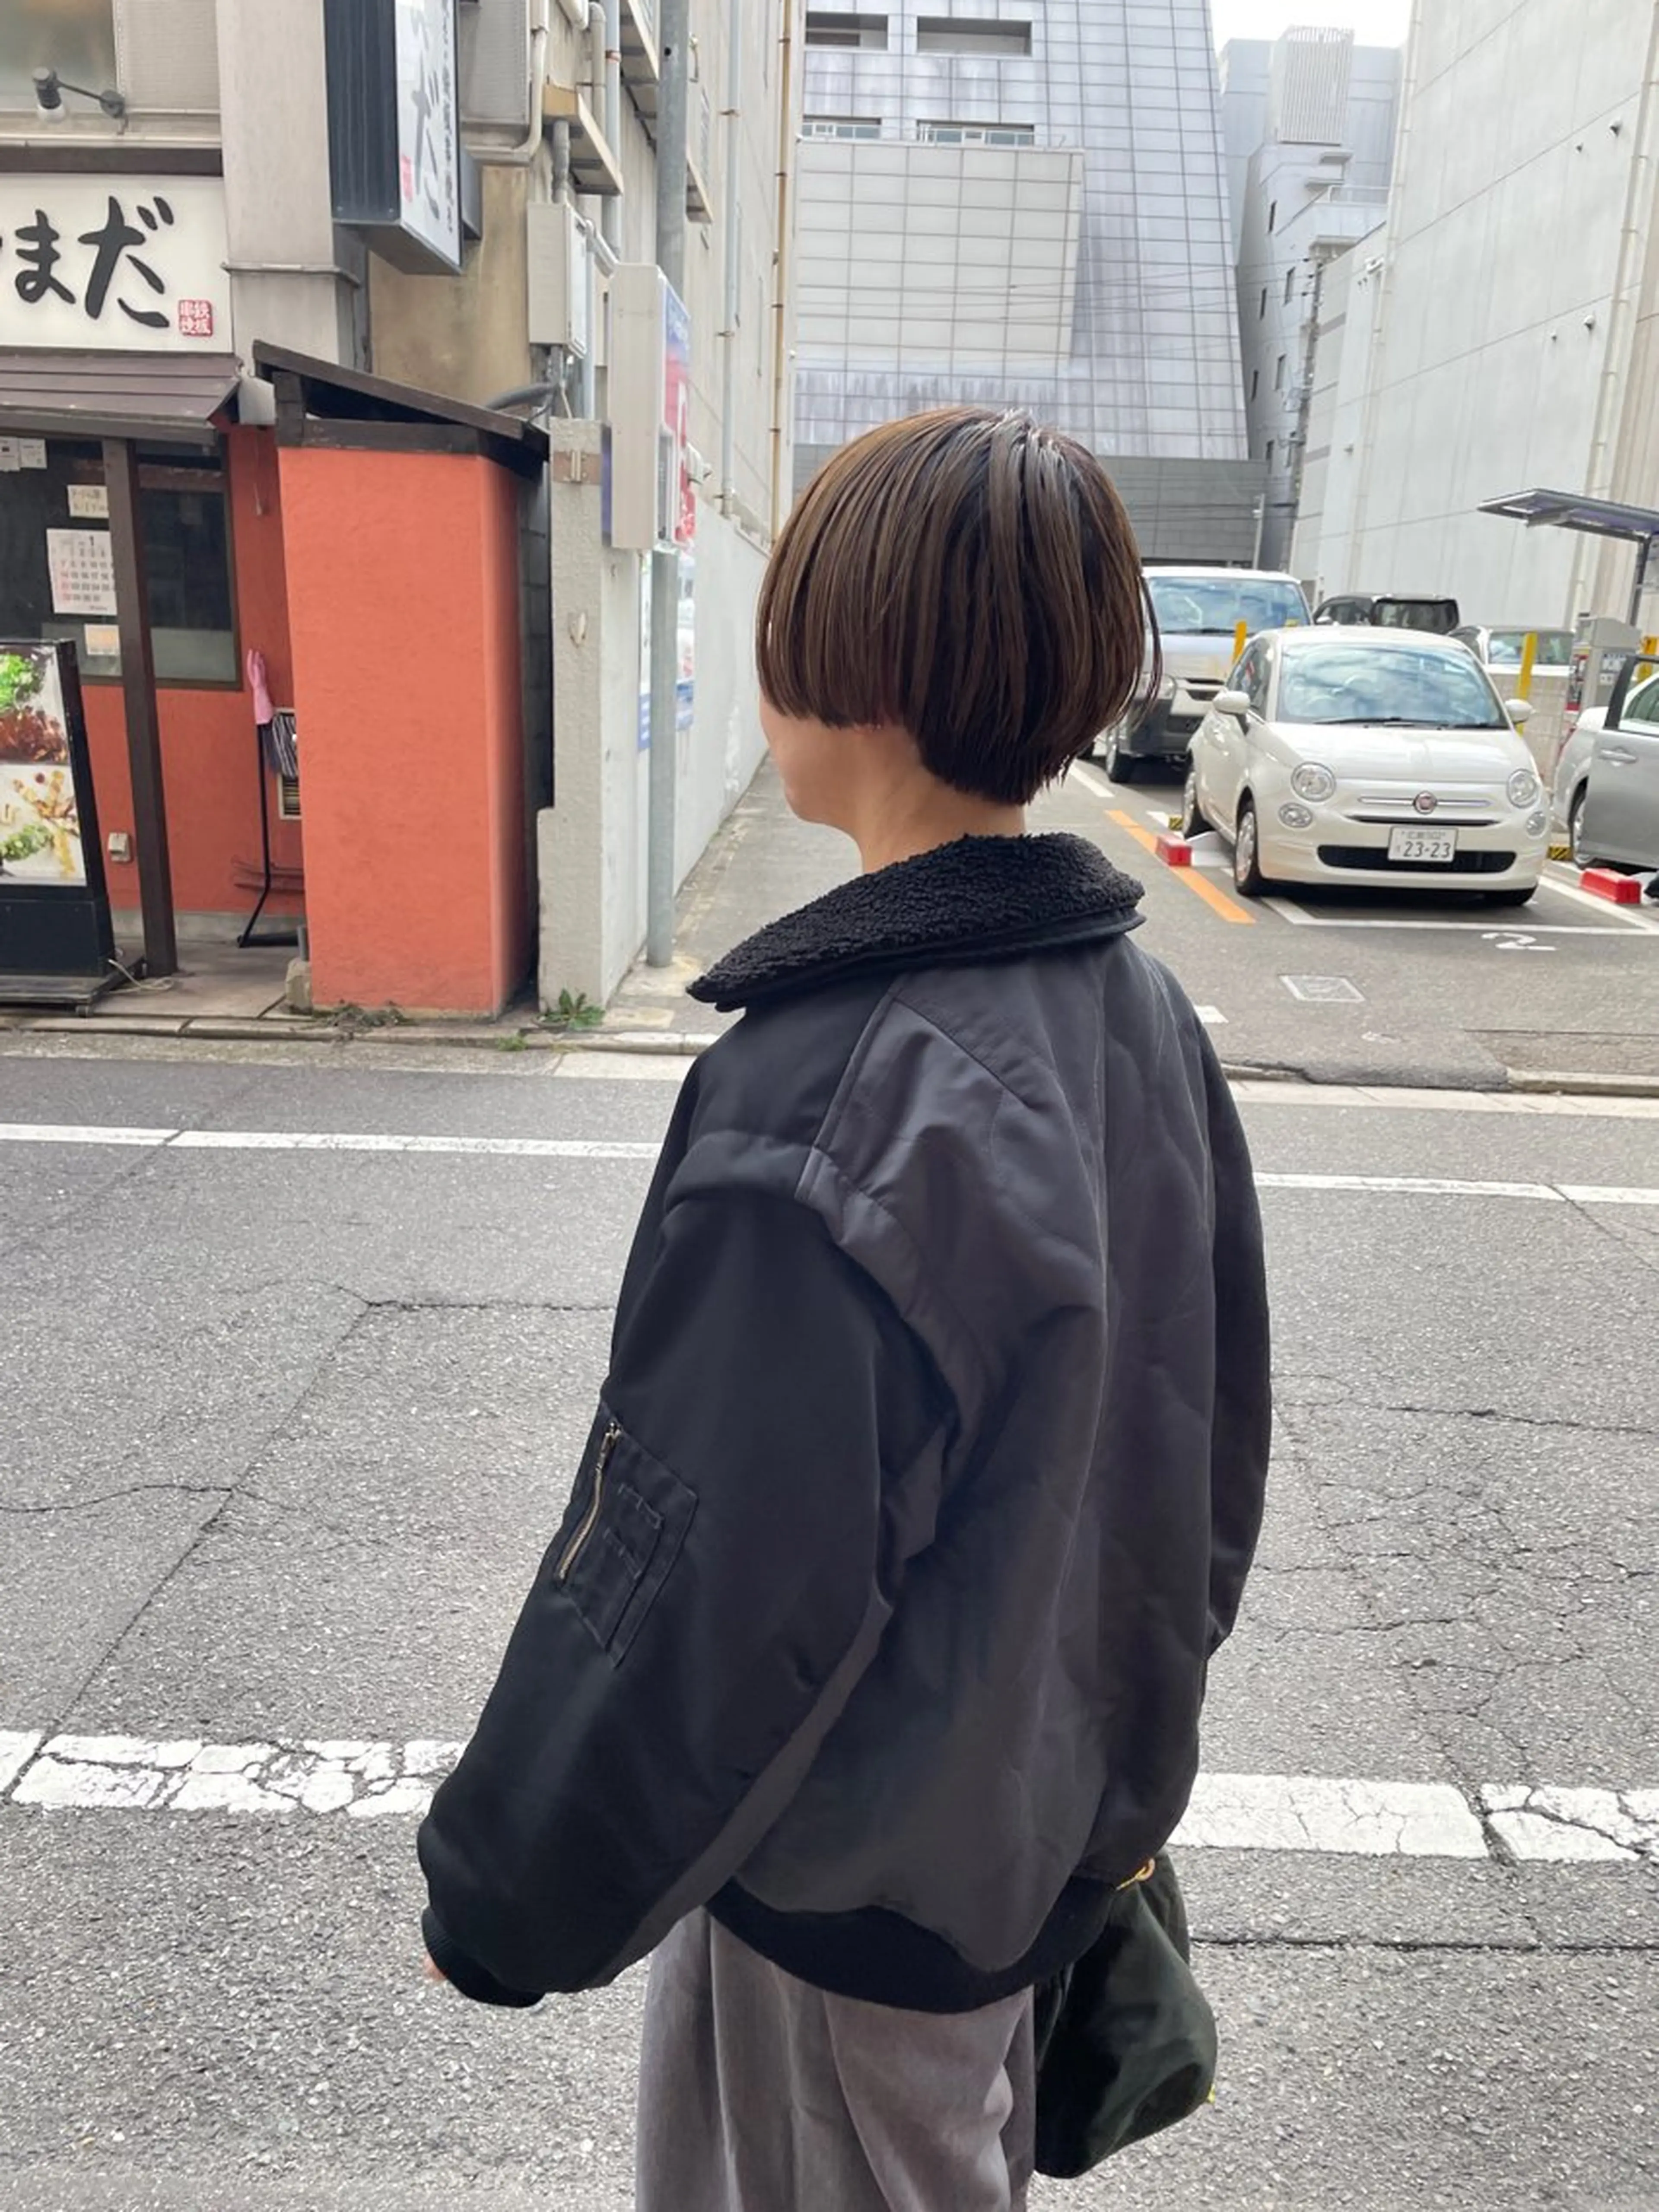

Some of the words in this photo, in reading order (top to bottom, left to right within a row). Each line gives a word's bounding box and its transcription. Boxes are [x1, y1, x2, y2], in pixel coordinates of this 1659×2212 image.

[0, 196, 174, 328] まだ
[1403, 841, 1451, 858] 23-23
[1481, 932, 1557, 951] 2
